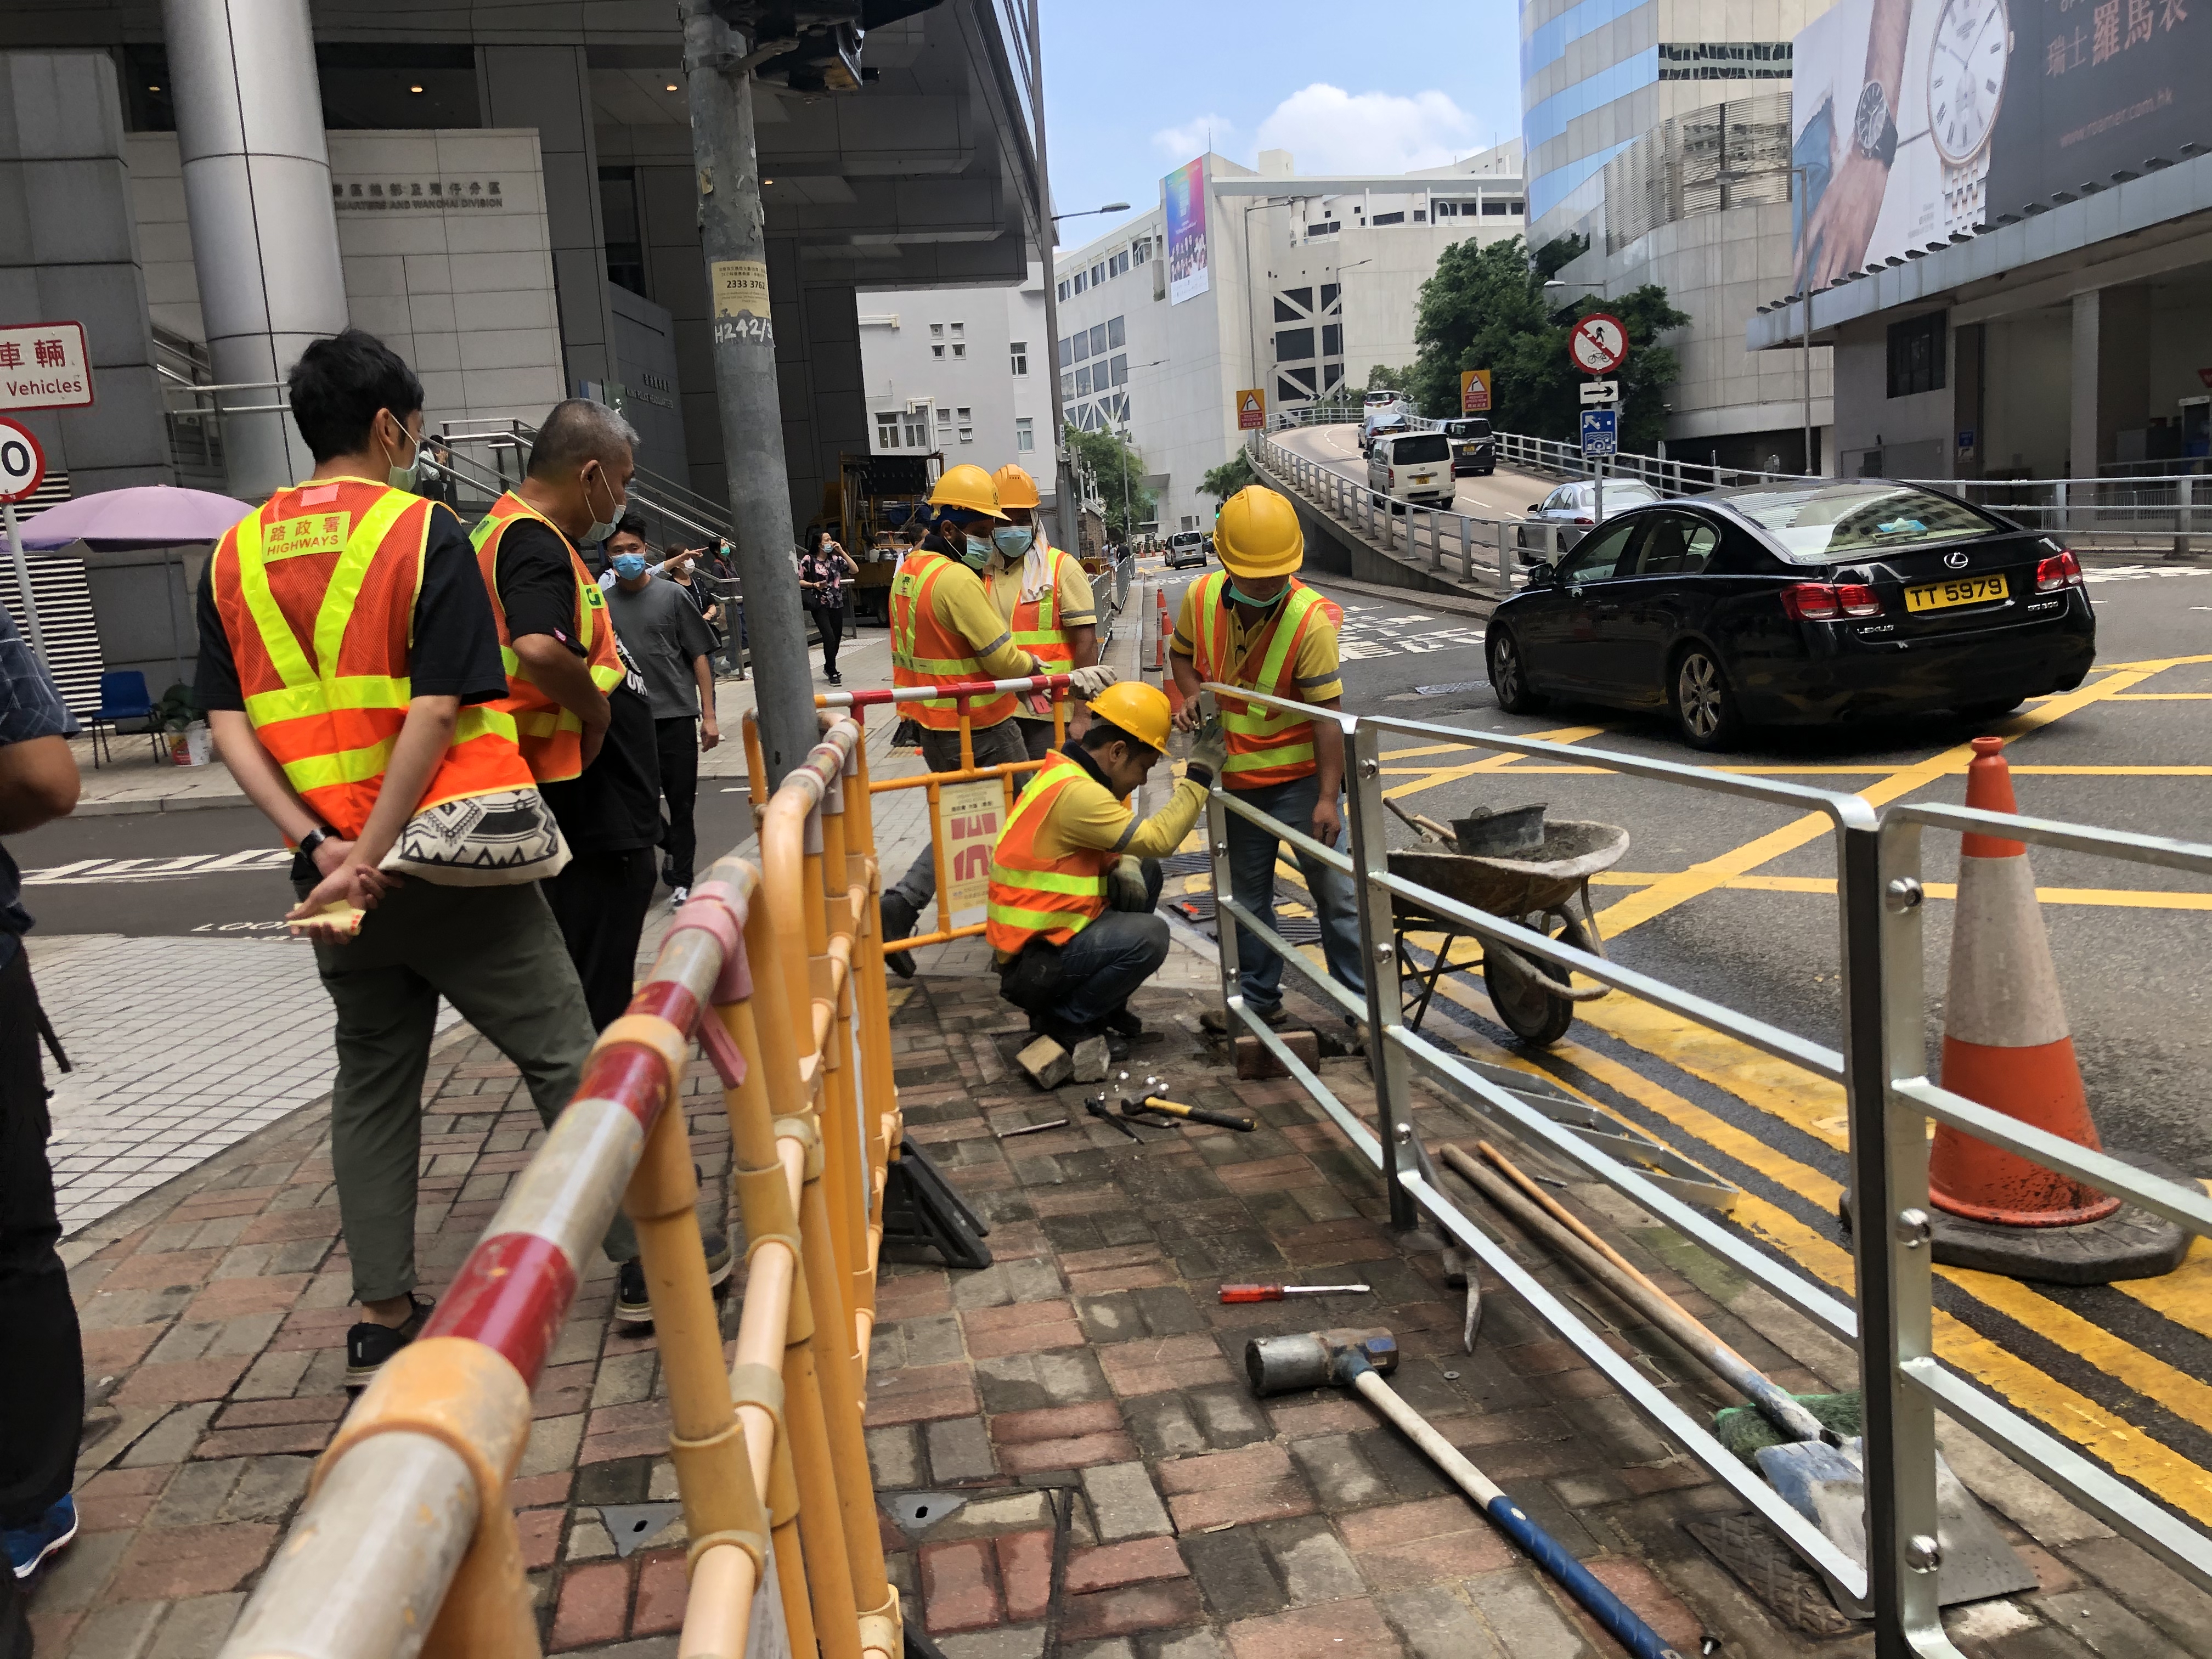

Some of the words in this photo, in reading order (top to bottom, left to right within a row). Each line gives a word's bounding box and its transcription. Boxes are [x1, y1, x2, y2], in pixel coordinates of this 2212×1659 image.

[461, 198, 503, 208] DIVISION
[750, 280, 765, 290] 3762
[0, 339, 66, 370] 車輛
[7, 379, 82, 396] Vehicles
[270, 516, 340, 543] 路政署
[267, 535, 338, 556] HIGHWAYS
[1910, 585, 1937, 607] TT
[1945, 578, 2002, 602] 5979
[190, 921, 291, 932] LOO
